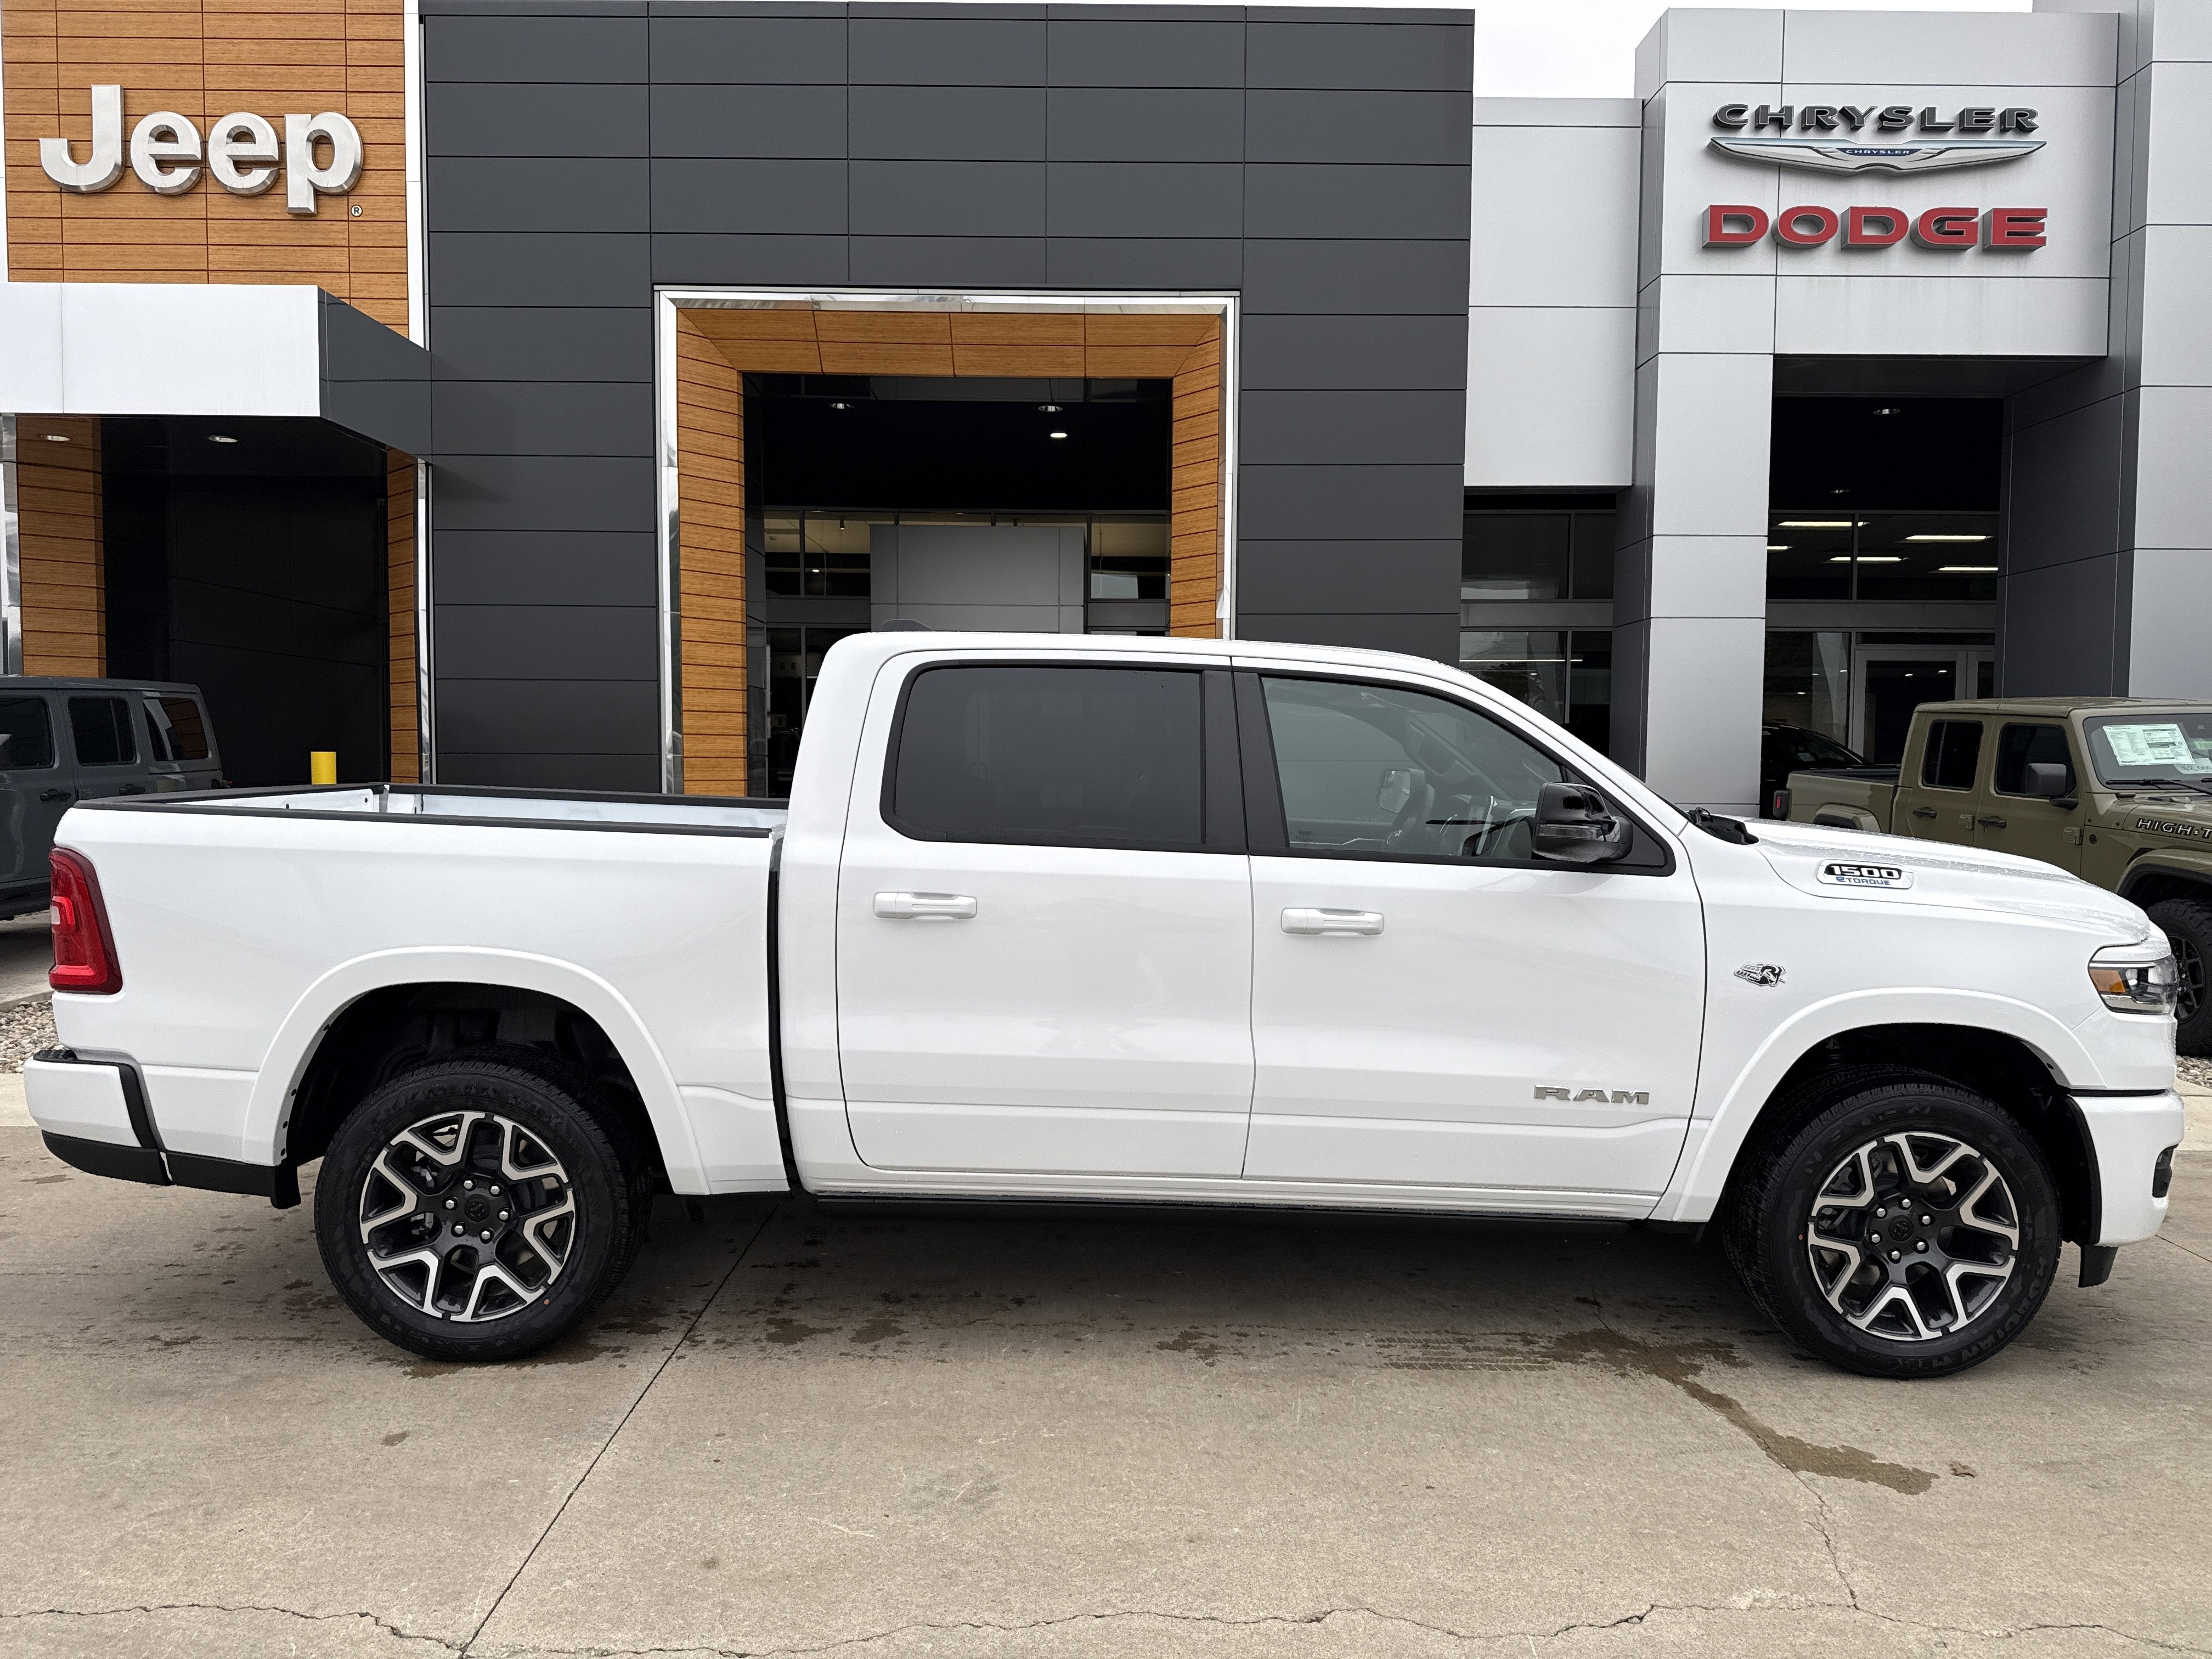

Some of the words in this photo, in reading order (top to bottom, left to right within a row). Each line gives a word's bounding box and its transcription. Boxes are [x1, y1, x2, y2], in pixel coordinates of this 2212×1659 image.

[1713, 104, 2040, 133] CHRYSLER
[38, 84, 363, 215] Jeep
[1702, 204, 2047, 252] DODGE
[1827, 865, 1900, 879] 1500
[1534, 1085, 1650, 1105] RAM
